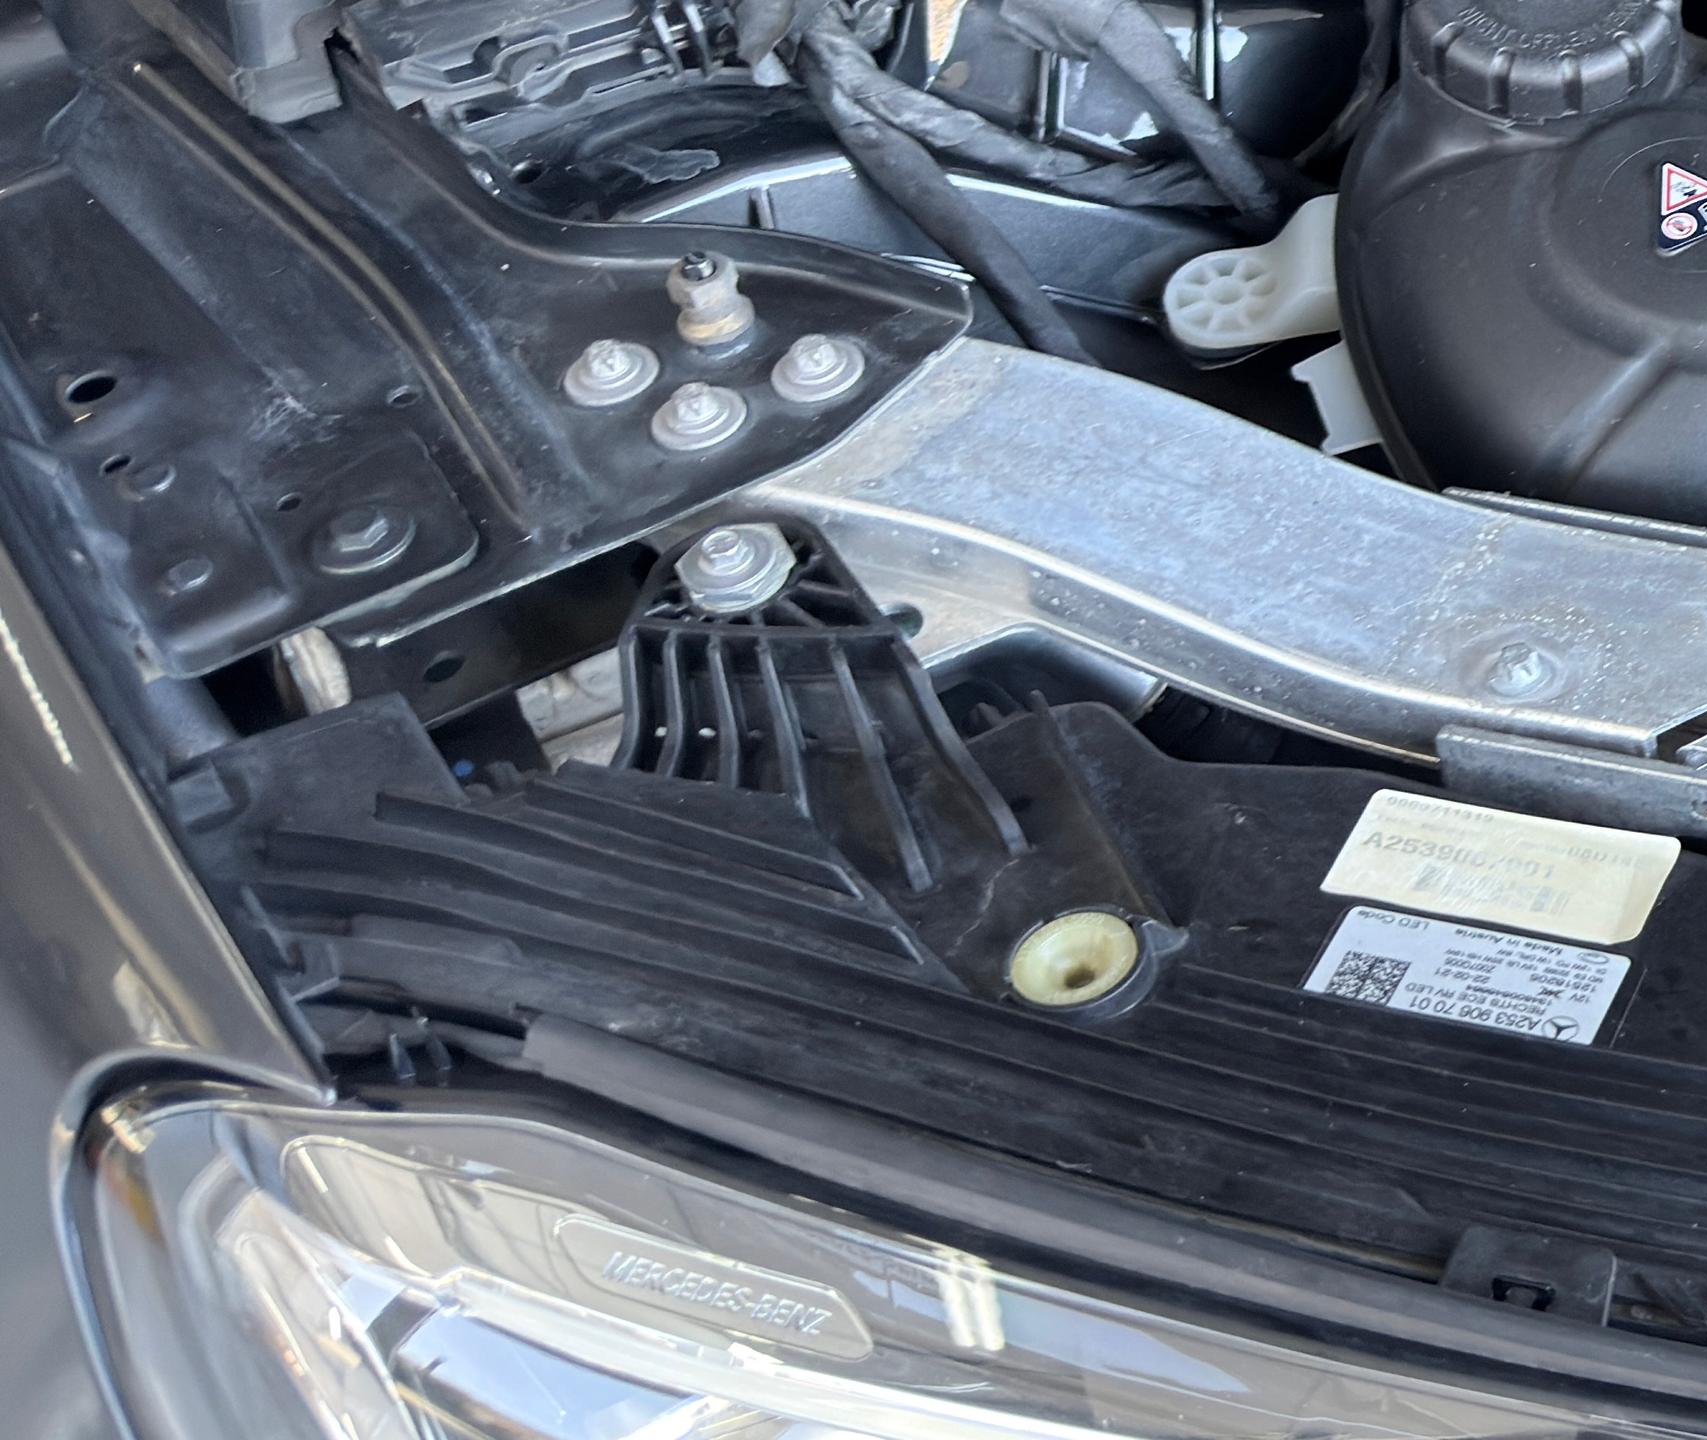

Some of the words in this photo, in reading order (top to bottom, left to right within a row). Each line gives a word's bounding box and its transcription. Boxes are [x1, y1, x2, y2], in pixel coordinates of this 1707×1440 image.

[1354, 909, 1396, 924] Code
[1397, 916, 1429, 930] LED
[1452, 927, 1502, 944] Austria
[1504, 938, 1520, 947] in
[1522, 941, 1563, 955] Made
[1403, 981, 1434, 995] LED
[1407, 994, 1432, 1010] 01
[1429, 998, 1457, 1015] 70
[1456, 1003, 1495, 1022] 906
[1492, 1010, 1542, 1032] A253
[603, 1251, 832, 1334] MERCEDES-BENZ
